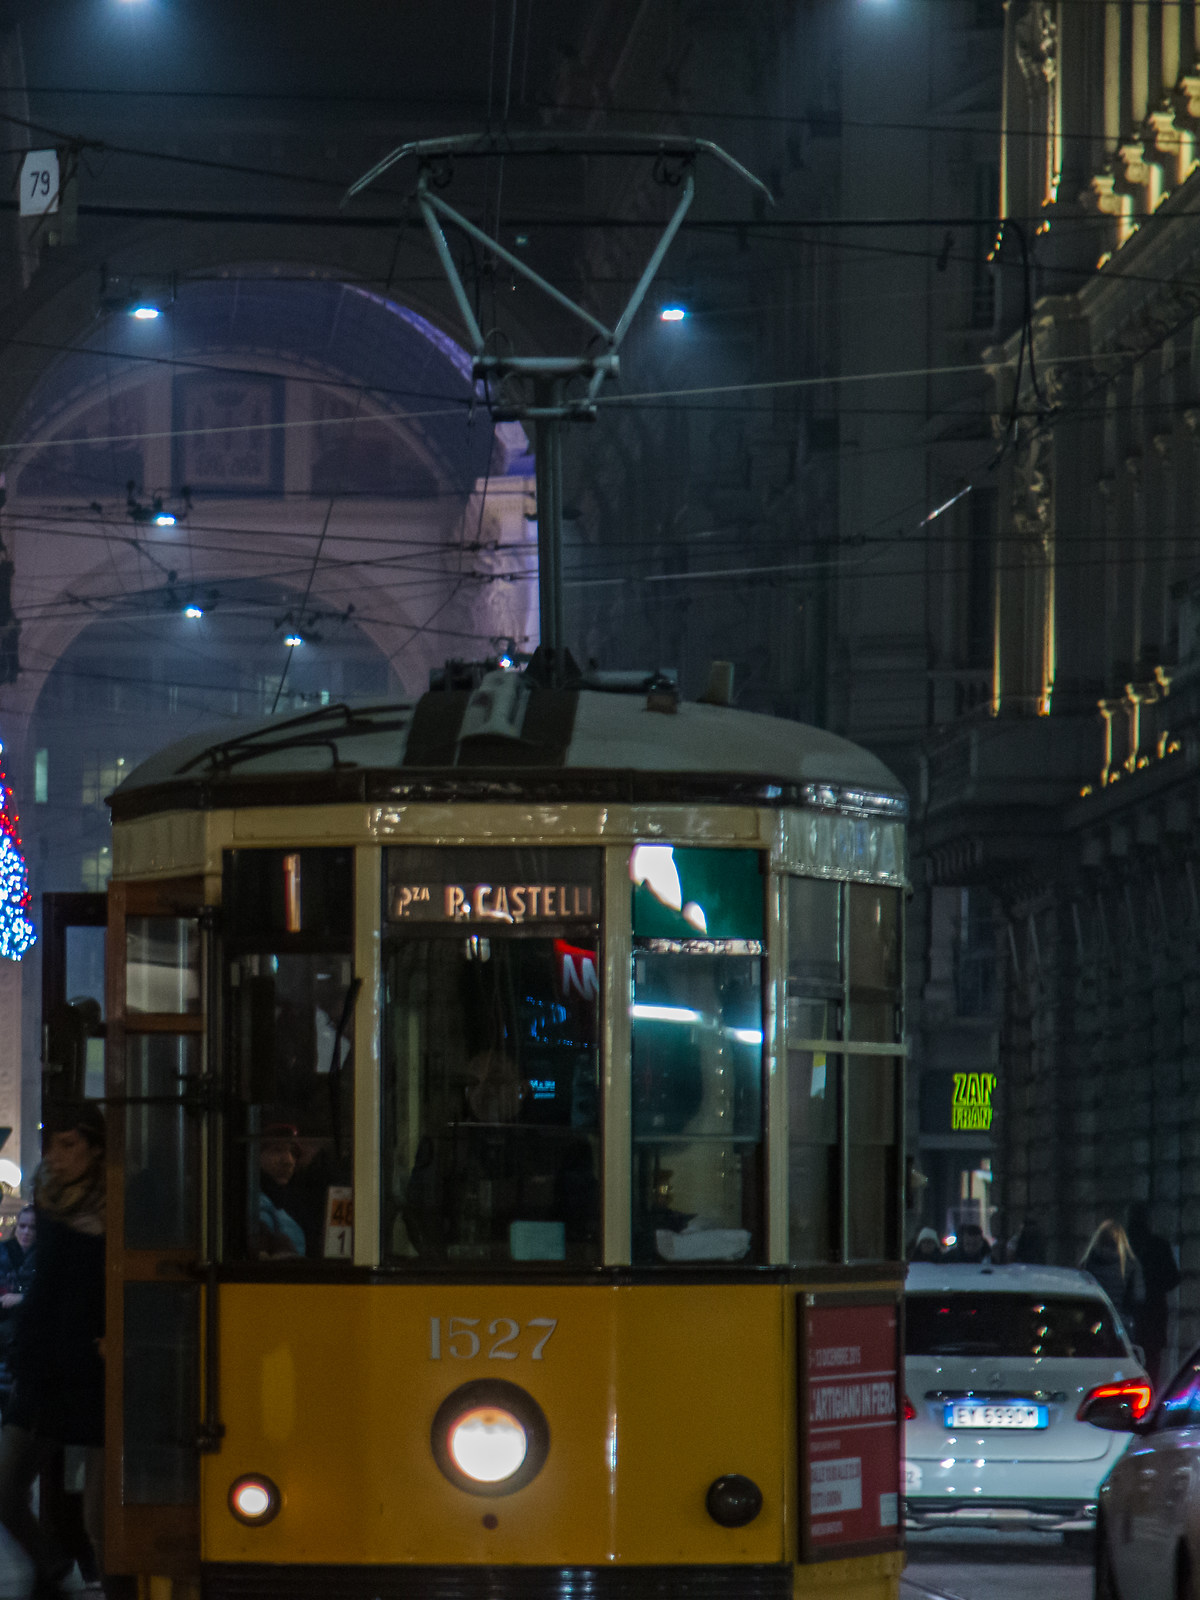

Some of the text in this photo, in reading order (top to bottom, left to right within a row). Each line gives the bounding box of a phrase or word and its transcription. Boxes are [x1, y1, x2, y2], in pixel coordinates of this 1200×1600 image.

[30, 170, 50, 198] 79
[475, 885, 592, 917] CASTELLI
[430, 1317, 558, 1360] 1527
[810, 1386, 860, 1421] 'ARTIGIANO
